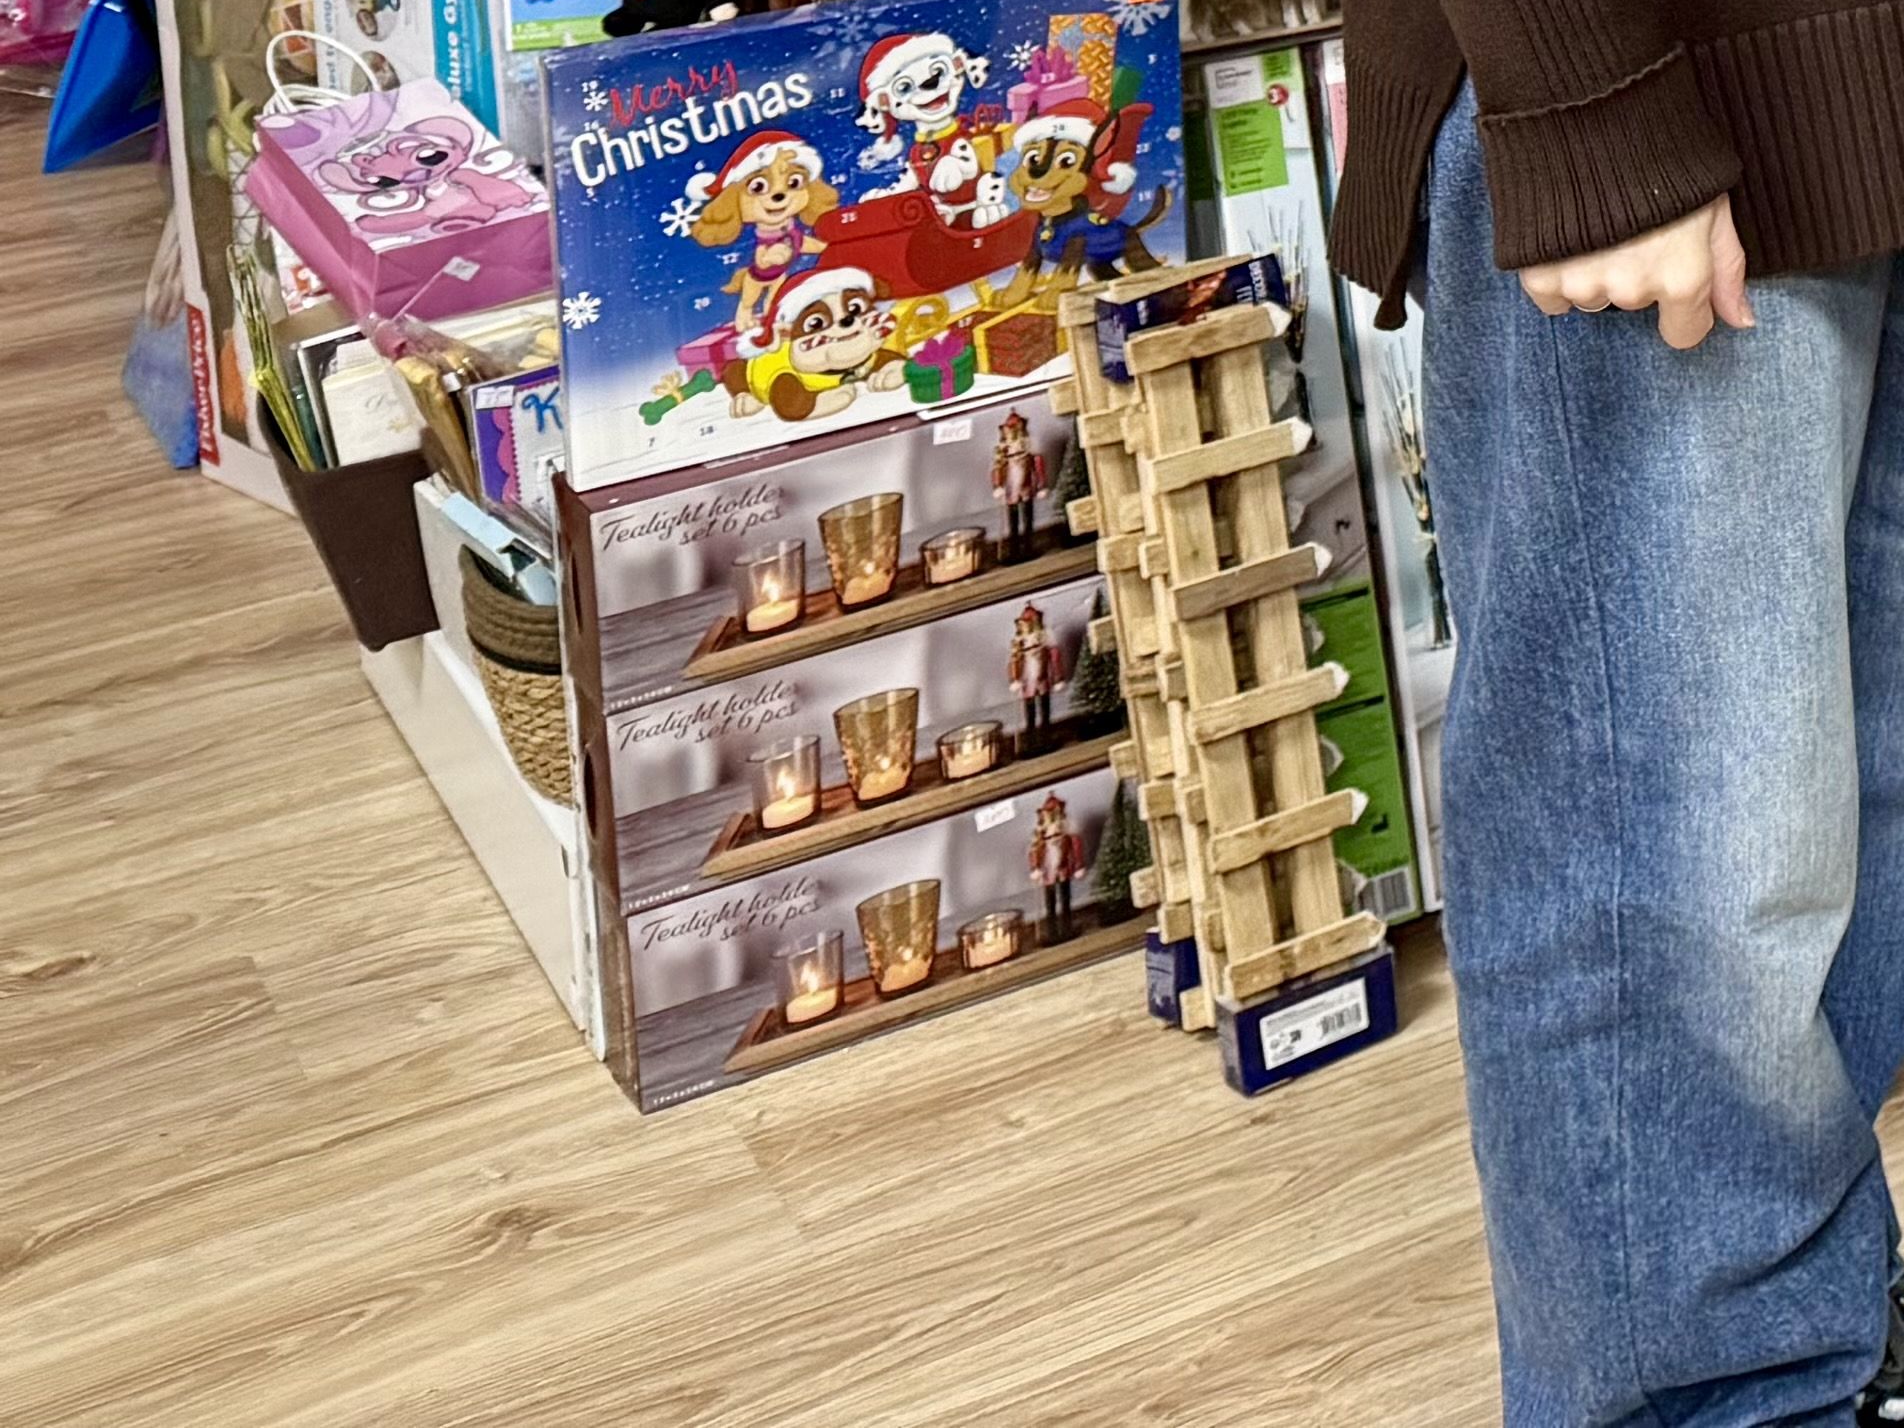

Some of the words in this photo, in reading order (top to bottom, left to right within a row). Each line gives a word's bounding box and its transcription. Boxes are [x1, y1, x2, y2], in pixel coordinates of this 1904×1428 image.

[609, 58, 740, 128] Merry
[570, 72, 813, 187] Christmas
[600, 498, 703, 552] Tealight
[679, 512, 717, 546] set
[720, 510, 739, 533] 6
[740, 503, 784, 538] pcs
[616, 699, 718, 753] Tealight
[694, 715, 734, 744] set
[736, 711, 755, 732] 6
[756, 699, 800, 734] pcs
[640, 897, 741, 952] Tealight
[719, 913, 760, 942] set
[760, 906, 779, 928] 6
[780, 894, 823, 929] pcs
